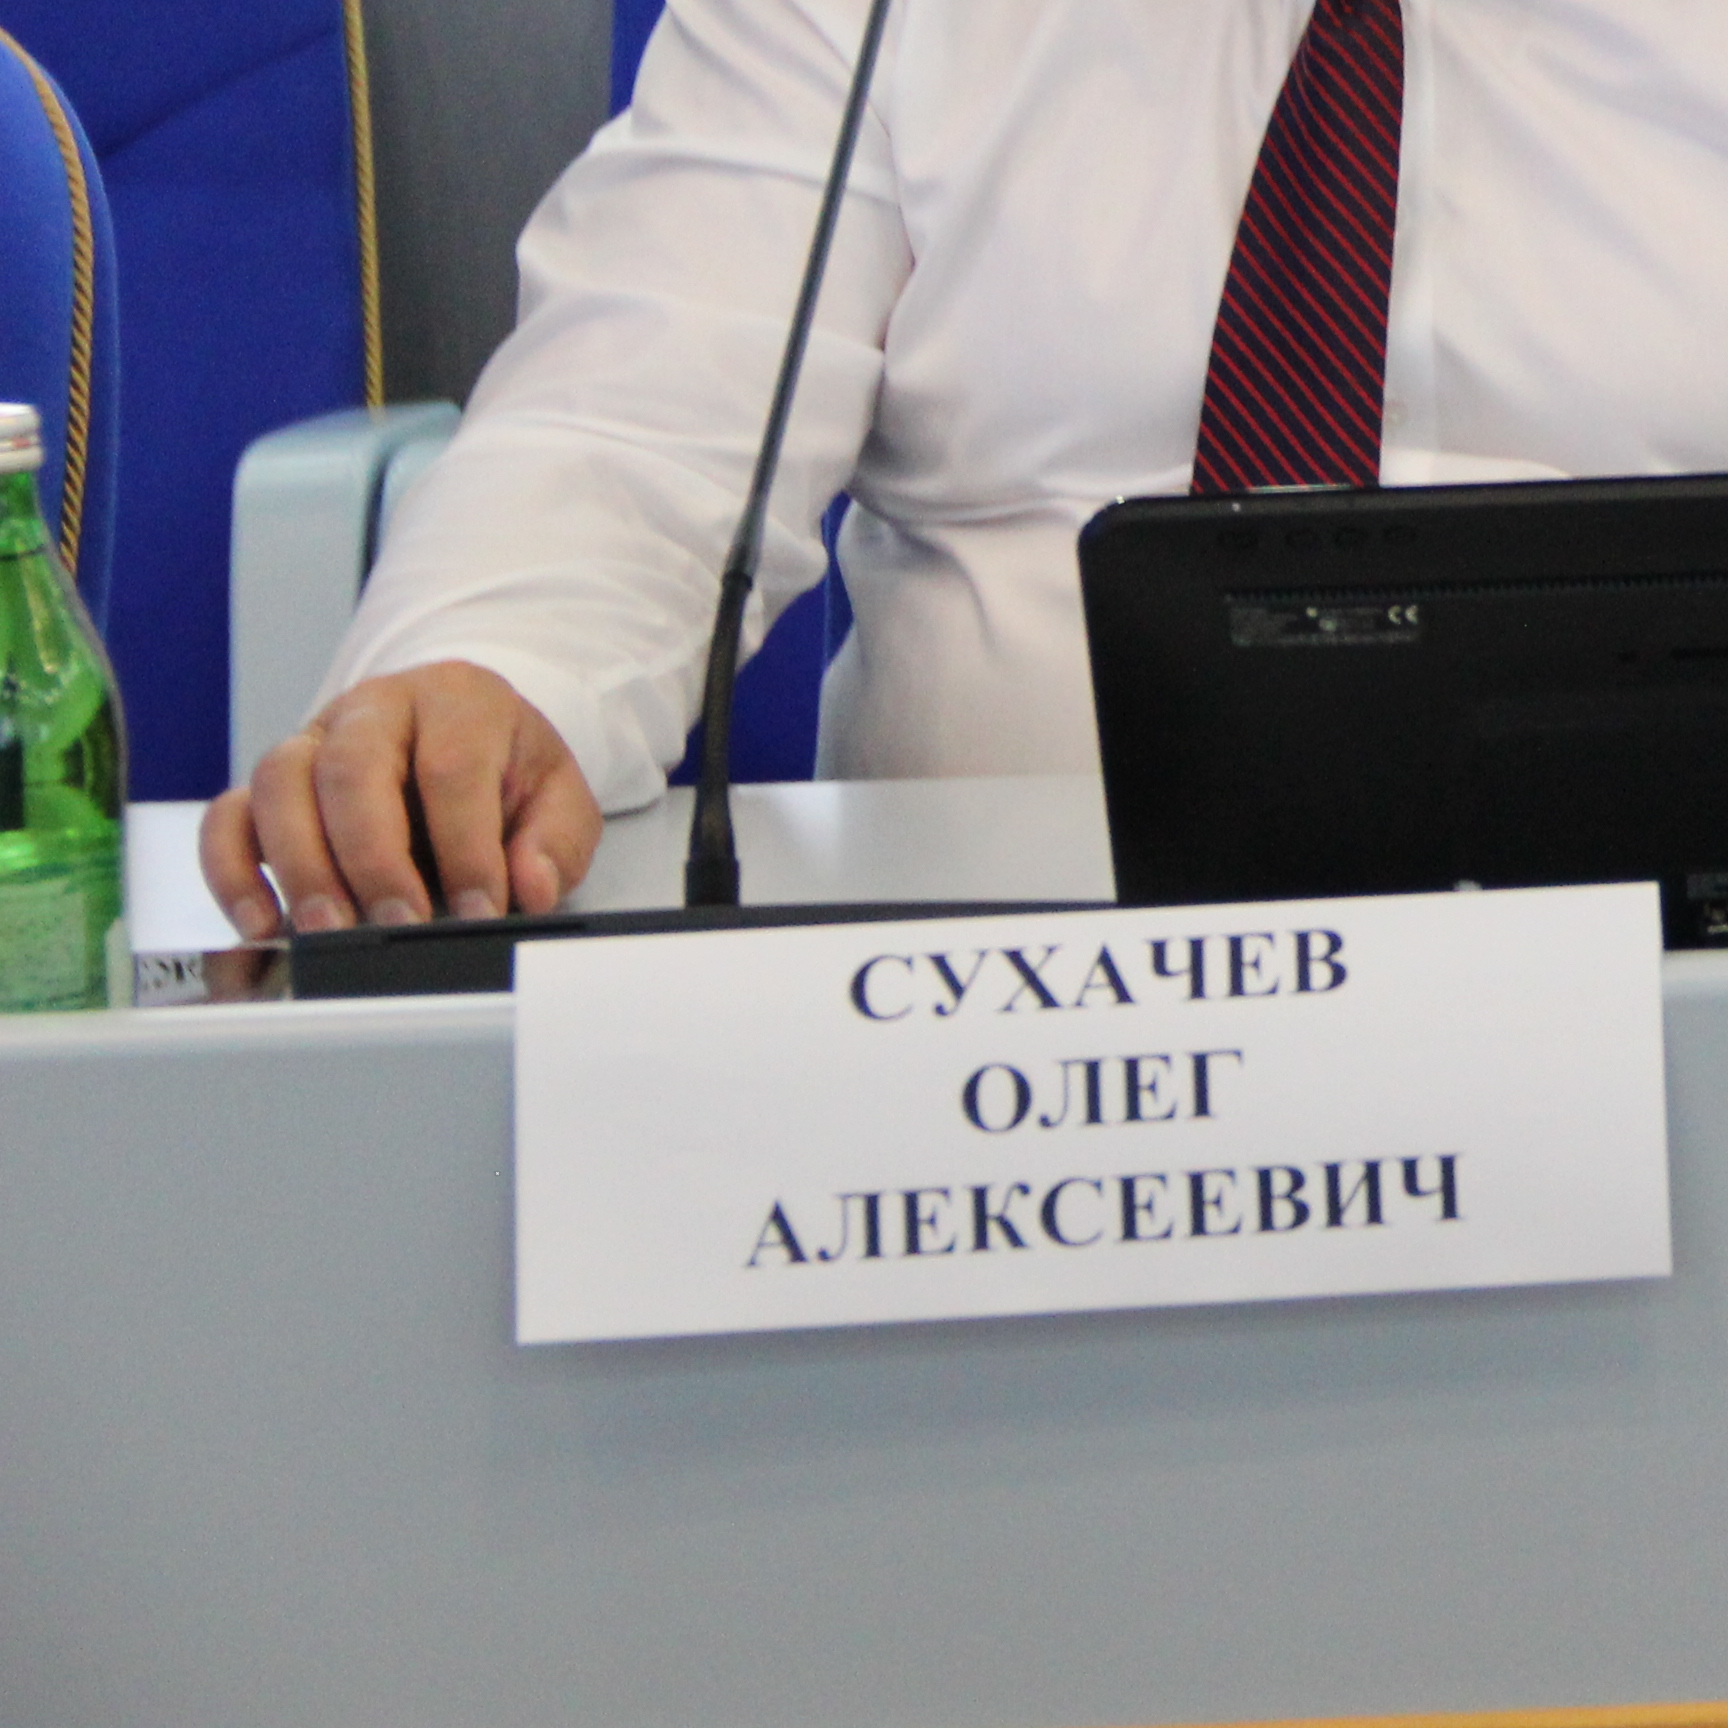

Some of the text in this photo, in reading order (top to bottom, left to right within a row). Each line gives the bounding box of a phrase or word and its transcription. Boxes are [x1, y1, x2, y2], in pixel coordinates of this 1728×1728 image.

[848, 928, 1348, 1021] СУХАЧЕВ
[960, 1049, 1243, 1133] ОЛЕГ
[745, 1152, 1463, 1268] АЛЕКСЕЕВИЧ
